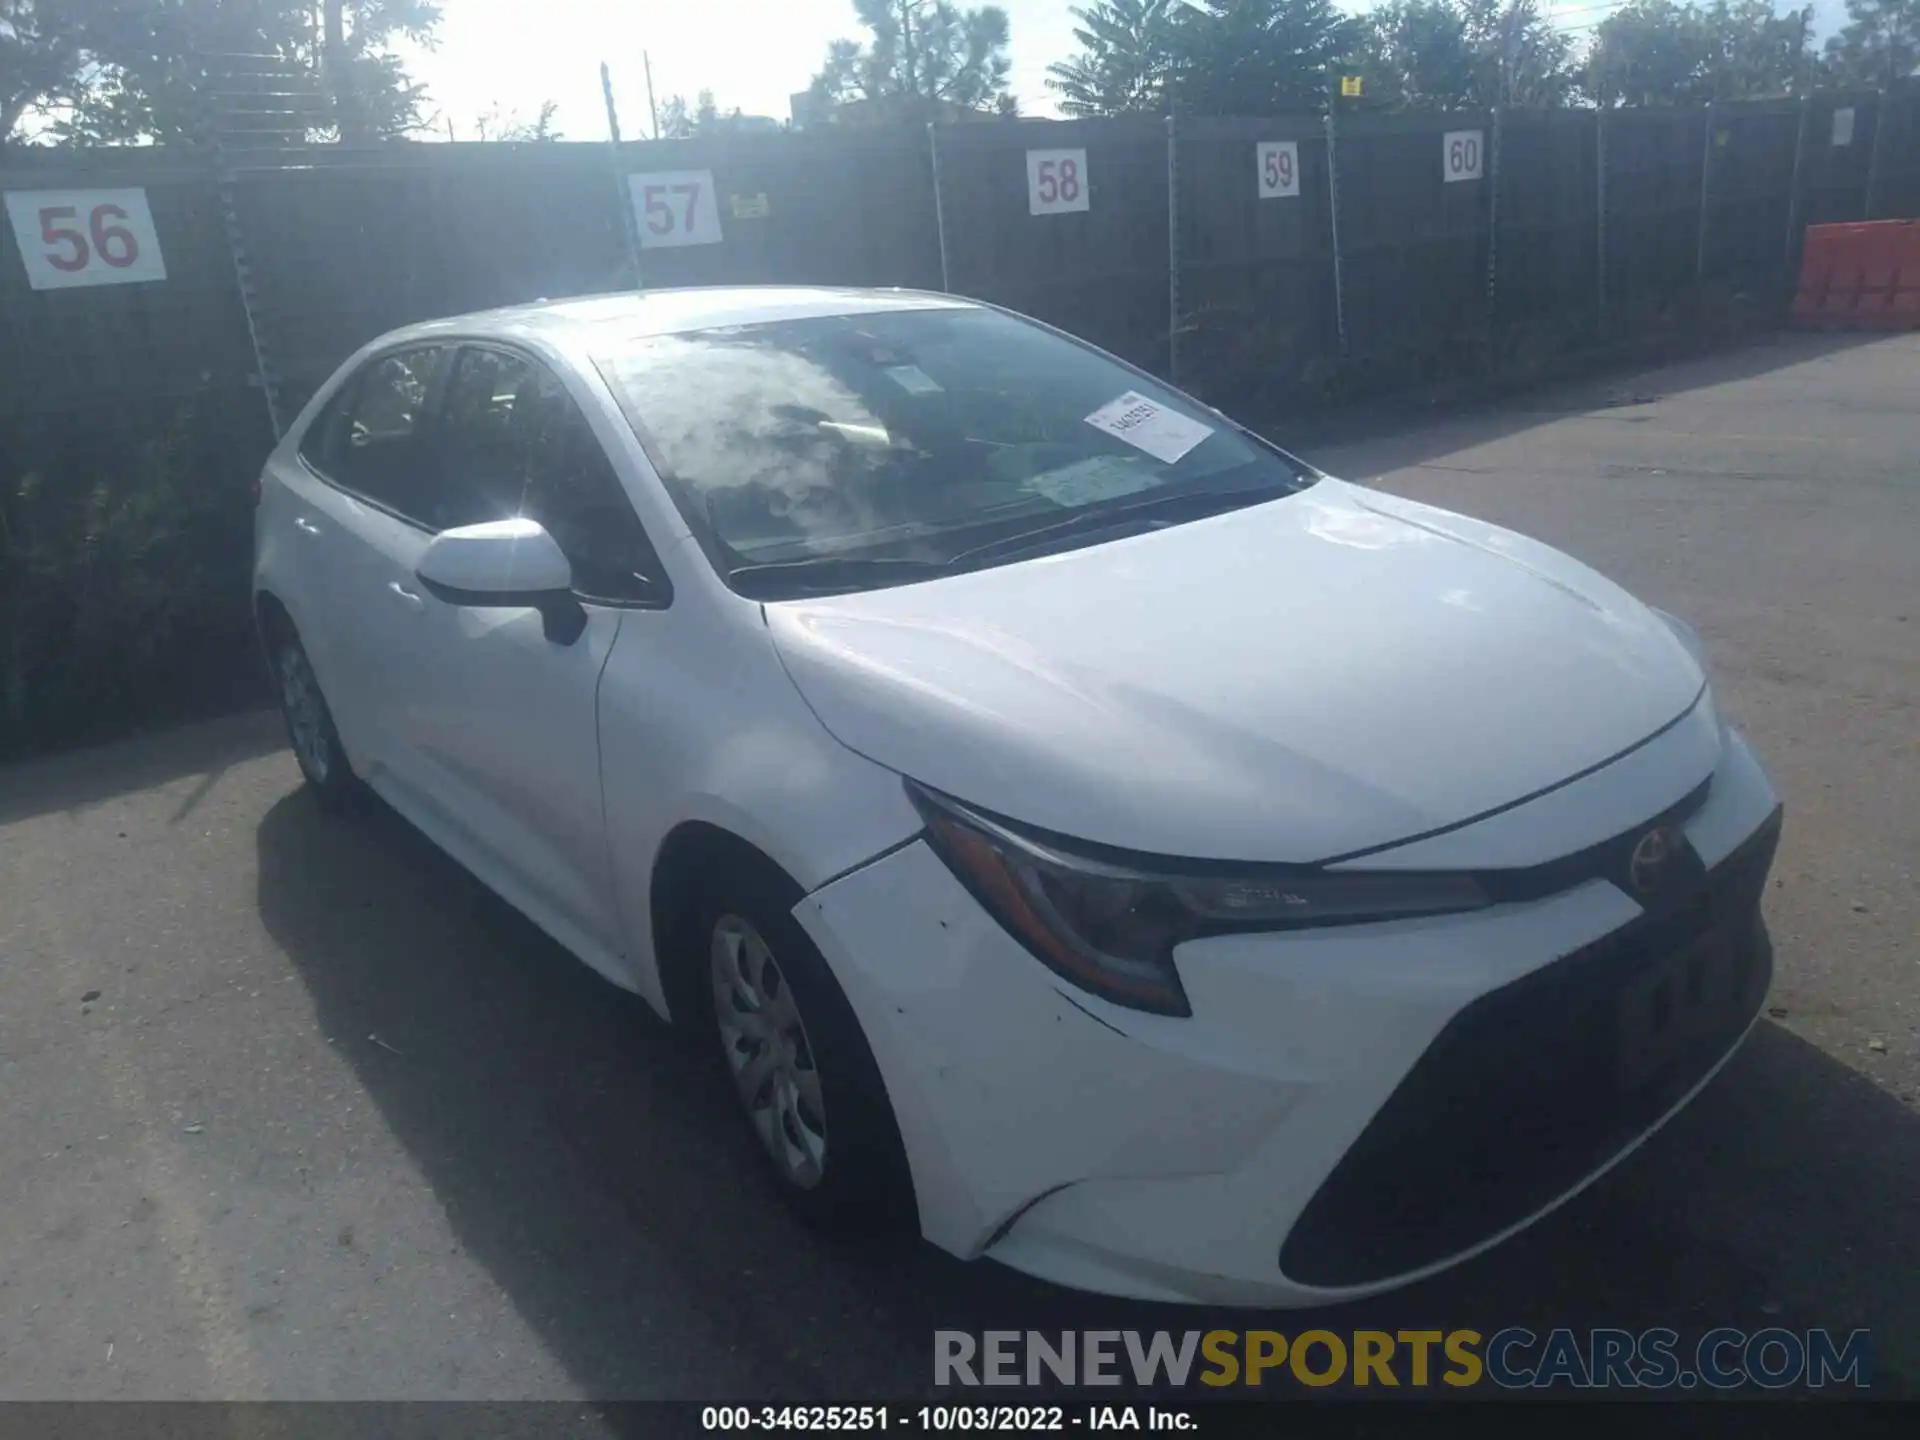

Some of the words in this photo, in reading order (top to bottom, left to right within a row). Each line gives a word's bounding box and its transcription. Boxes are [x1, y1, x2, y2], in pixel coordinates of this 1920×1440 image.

[1265, 151, 1292, 189] 59
[1451, 139, 1477, 174] 60
[1038, 159, 1079, 203] 58
[644, 183, 701, 235] 57
[39, 204, 138, 272] 56
